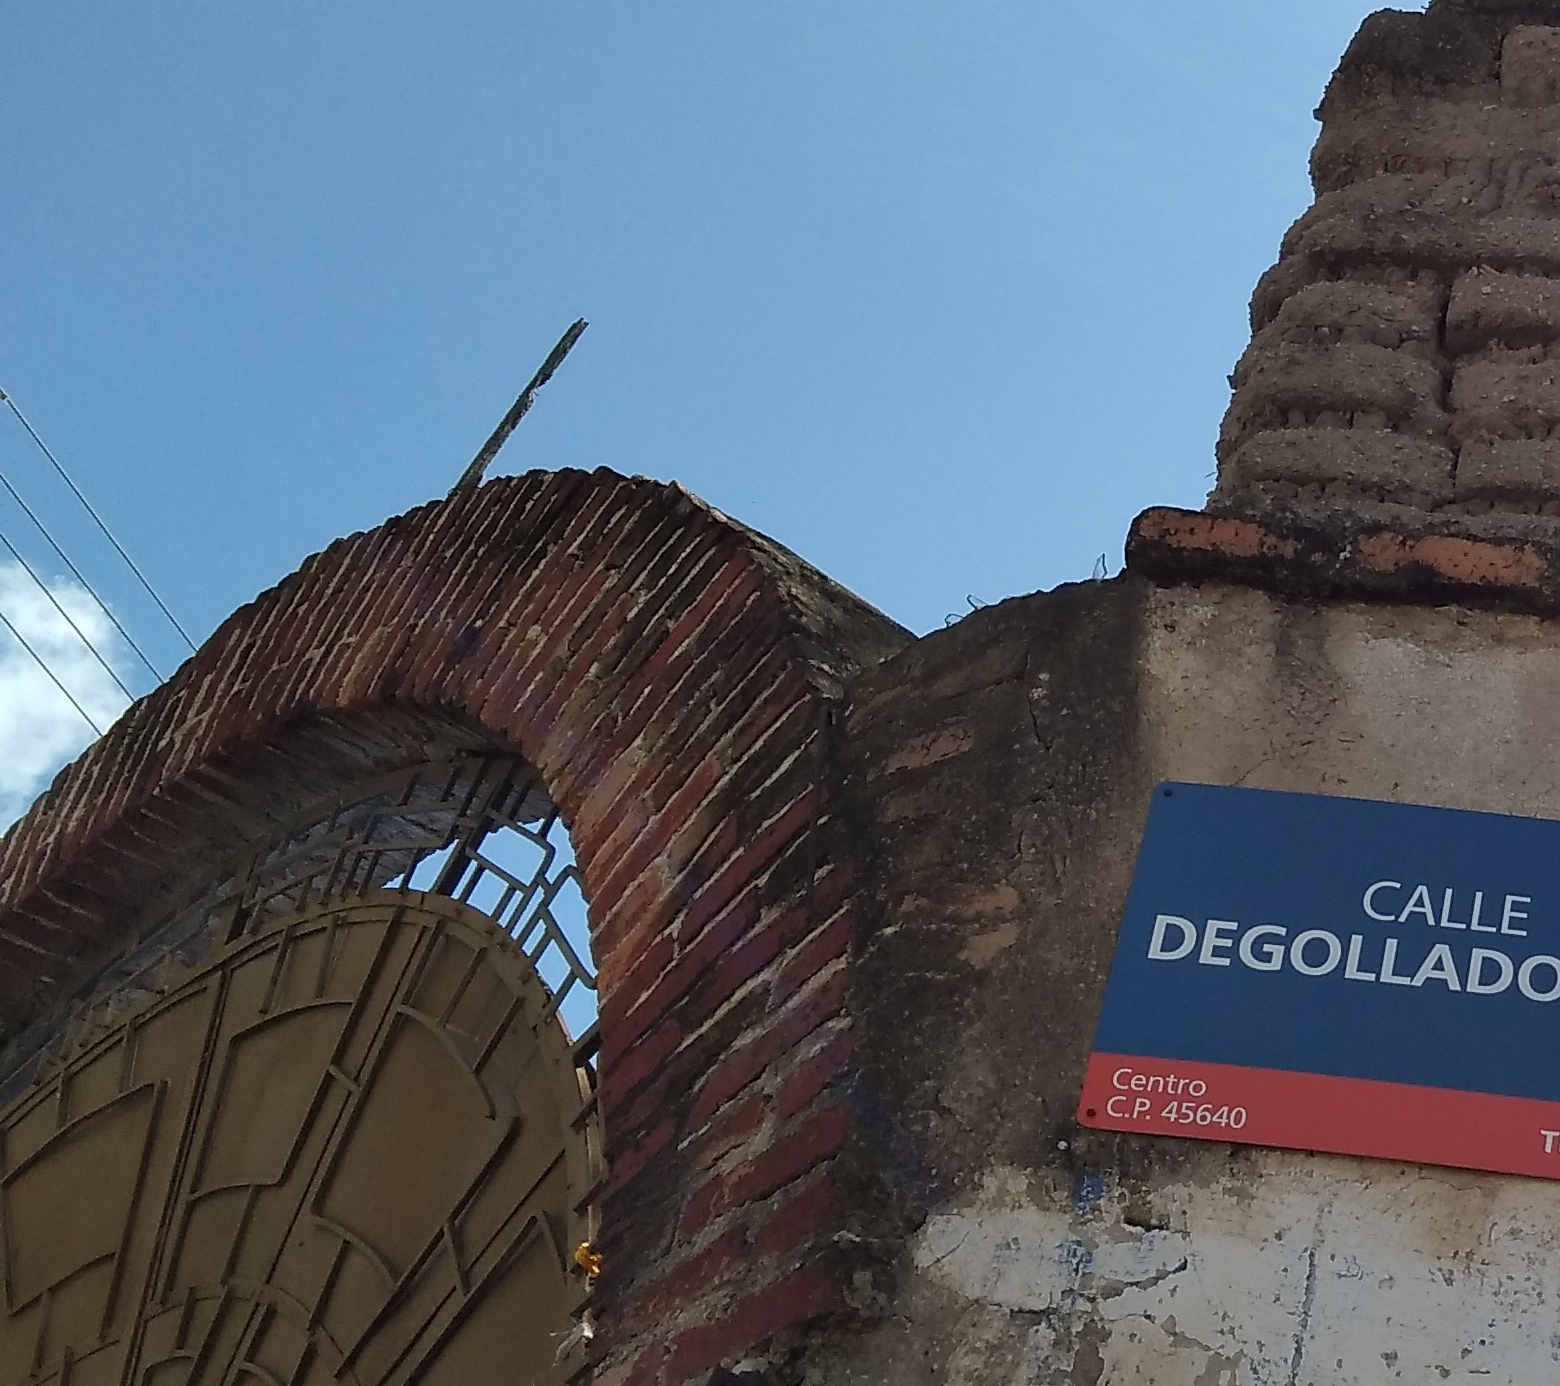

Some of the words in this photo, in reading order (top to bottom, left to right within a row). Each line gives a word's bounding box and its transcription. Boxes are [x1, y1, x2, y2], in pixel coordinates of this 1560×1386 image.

[1362, 880, 1532, 937] CALLE
[1112, 1068, 1207, 1096] Centro
[1106, 1095, 1151, 1120] C.P.
[1160, 1100, 1247, 1129] 45640
